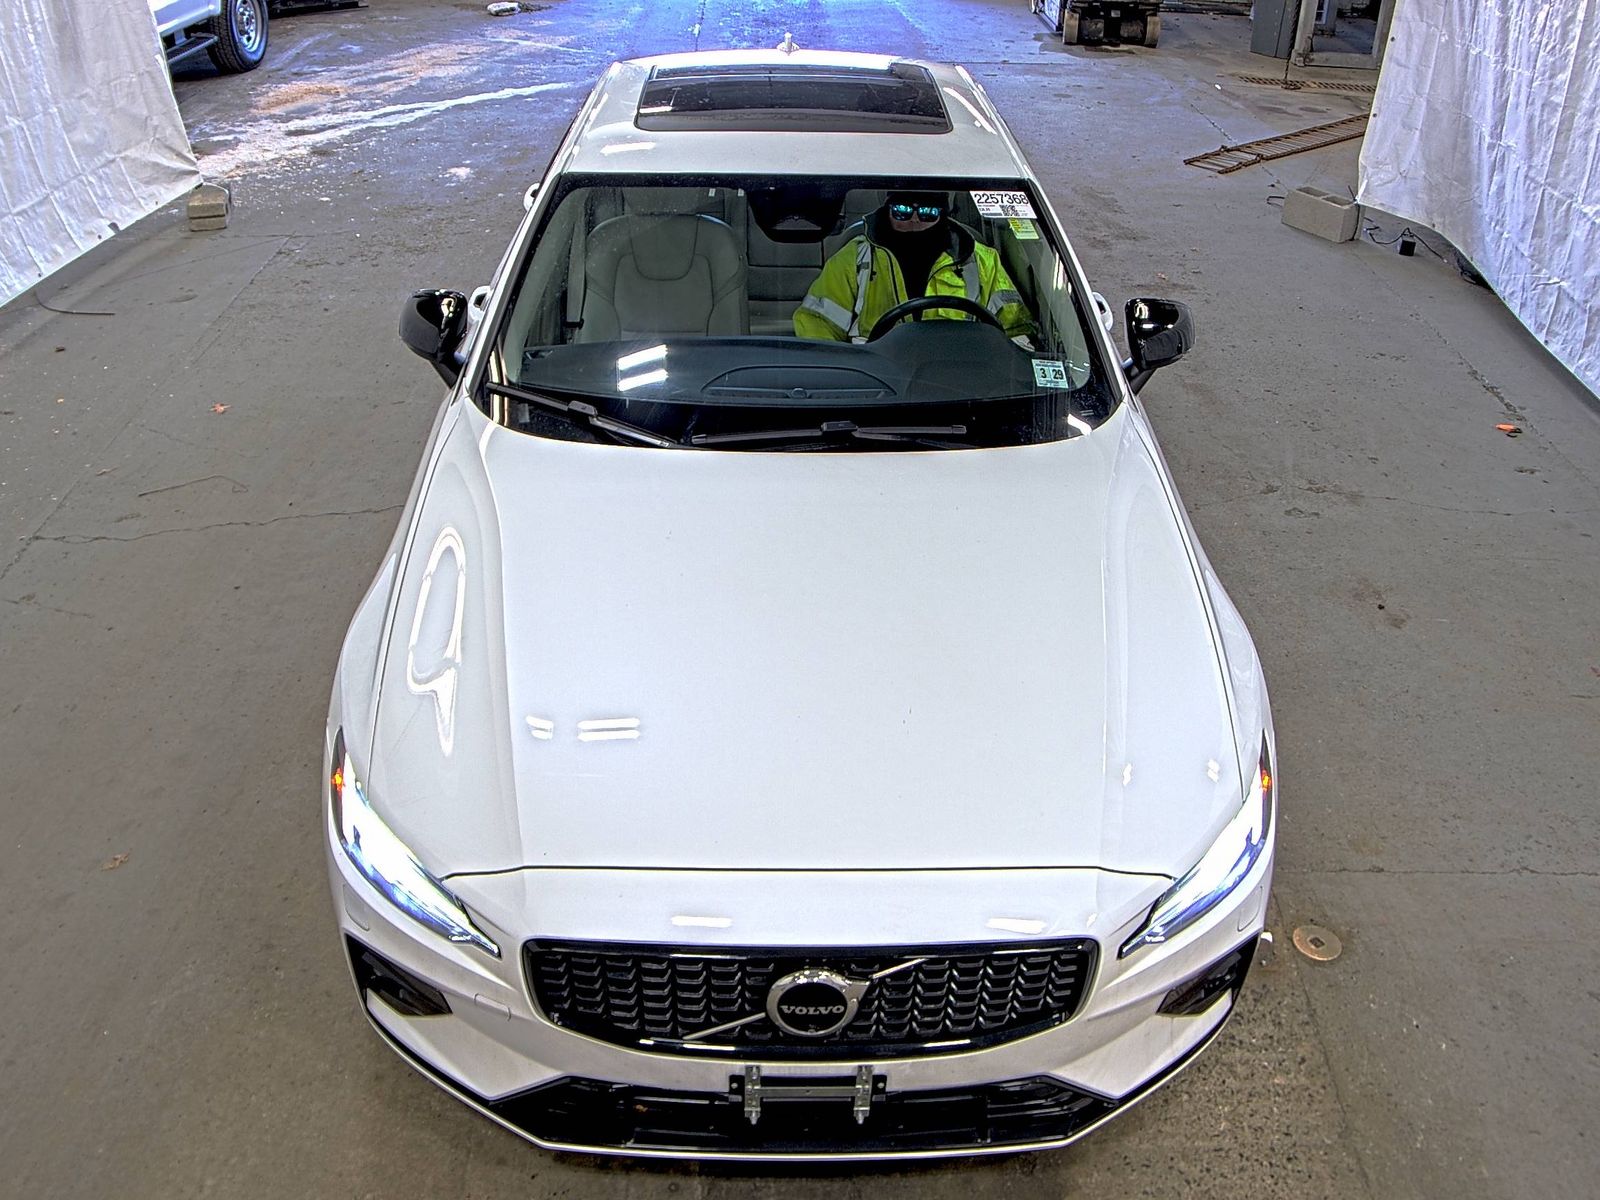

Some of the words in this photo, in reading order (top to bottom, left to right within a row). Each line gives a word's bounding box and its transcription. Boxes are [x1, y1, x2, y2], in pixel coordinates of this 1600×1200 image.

[974, 193, 1029, 204] 2257368
[1040, 368, 1047, 378] 3
[1052, 369, 1063, 379] 29
[780, 1005, 844, 1014] VOLVO
